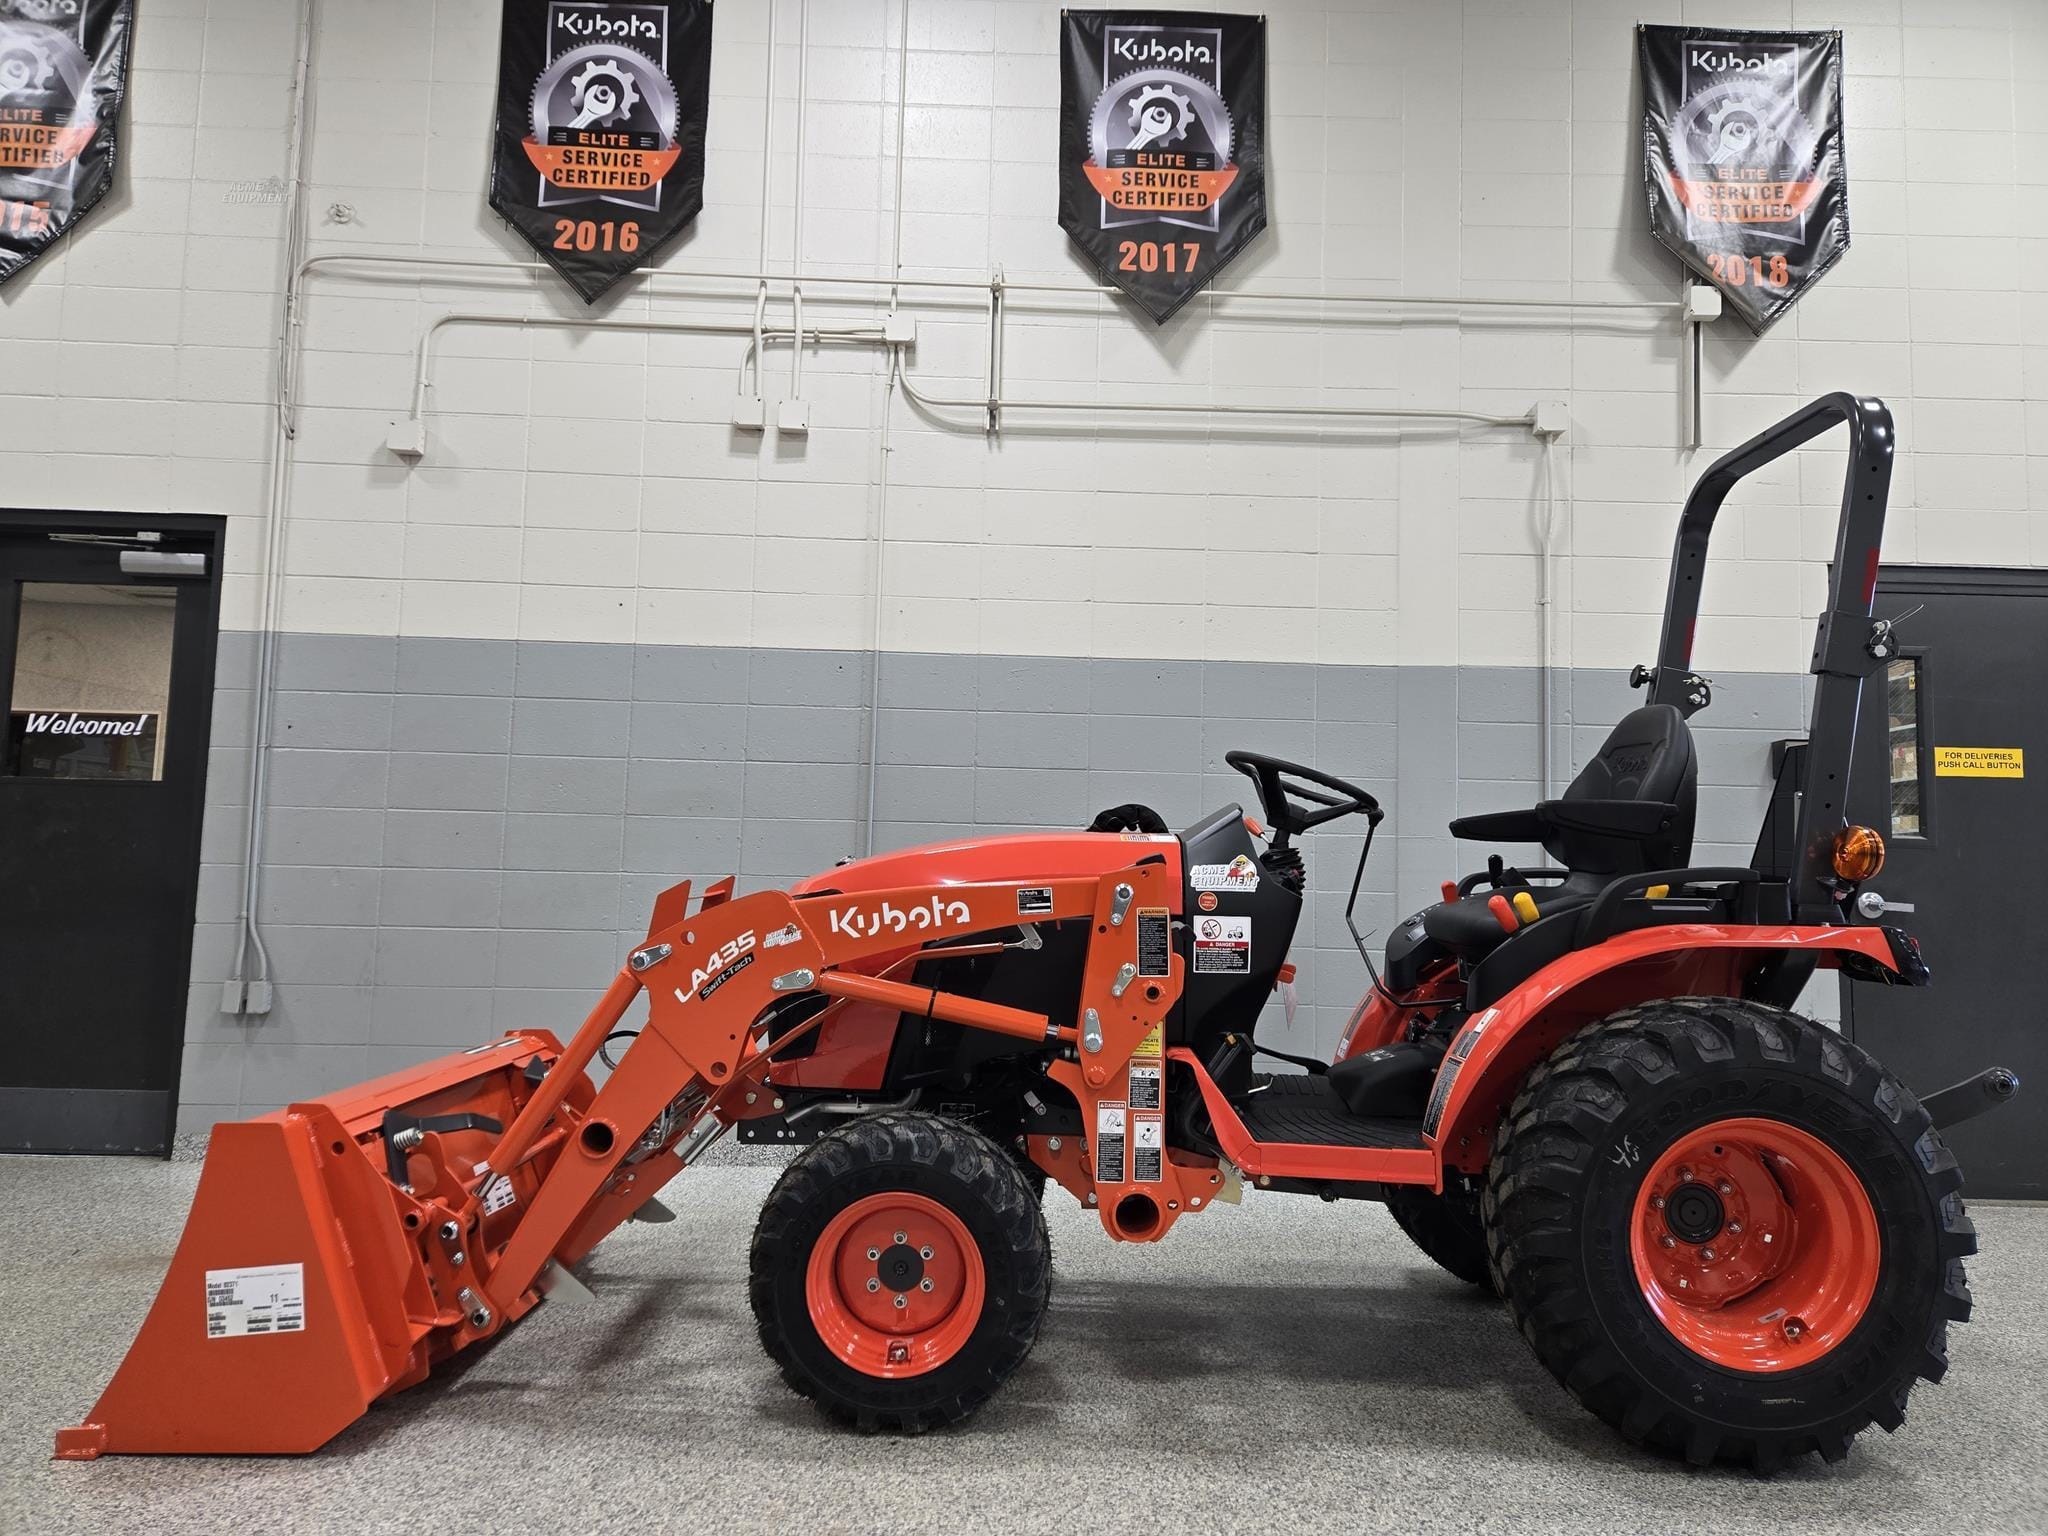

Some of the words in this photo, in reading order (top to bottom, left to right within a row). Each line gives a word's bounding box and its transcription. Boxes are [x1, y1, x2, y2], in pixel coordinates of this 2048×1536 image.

[557, 12, 658, 38] Kubota
[1113, 37, 1212, 63] Kubota
[1692, 50, 1788, 75] Kubota
[579, 131, 630, 147] ELITE
[562, 149, 643, 168] SERVICE
[1136, 153, 1186, 167] ELITE
[552, 168, 652, 187] CERTIFIED
[1121, 171, 1200, 188] SERVICE
[1718, 168, 1768, 180] ELITE
[221, 192, 290, 204] EQUIPMENT
[1112, 190, 1209, 207] CERTIFIED
[1703, 185, 1785, 200] SERVICE
[1696, 203, 1793, 218] CERTIFIED
[553, 219, 640, 252] 2016
[1119, 241, 1201, 273] 2017
[1706, 253, 1789, 288] 2018
[25, 713, 149, 736] Welcome!
[1962, 761, 1985, 769] CALL
[1192, 865, 1226, 877] ACME
[1192, 875, 1259, 889] EQUIPMENT
[830, 895, 971, 938] Kubota
[673, 929, 757, 1003] LA435
[701, 955, 752, 999] Swift-Tach
